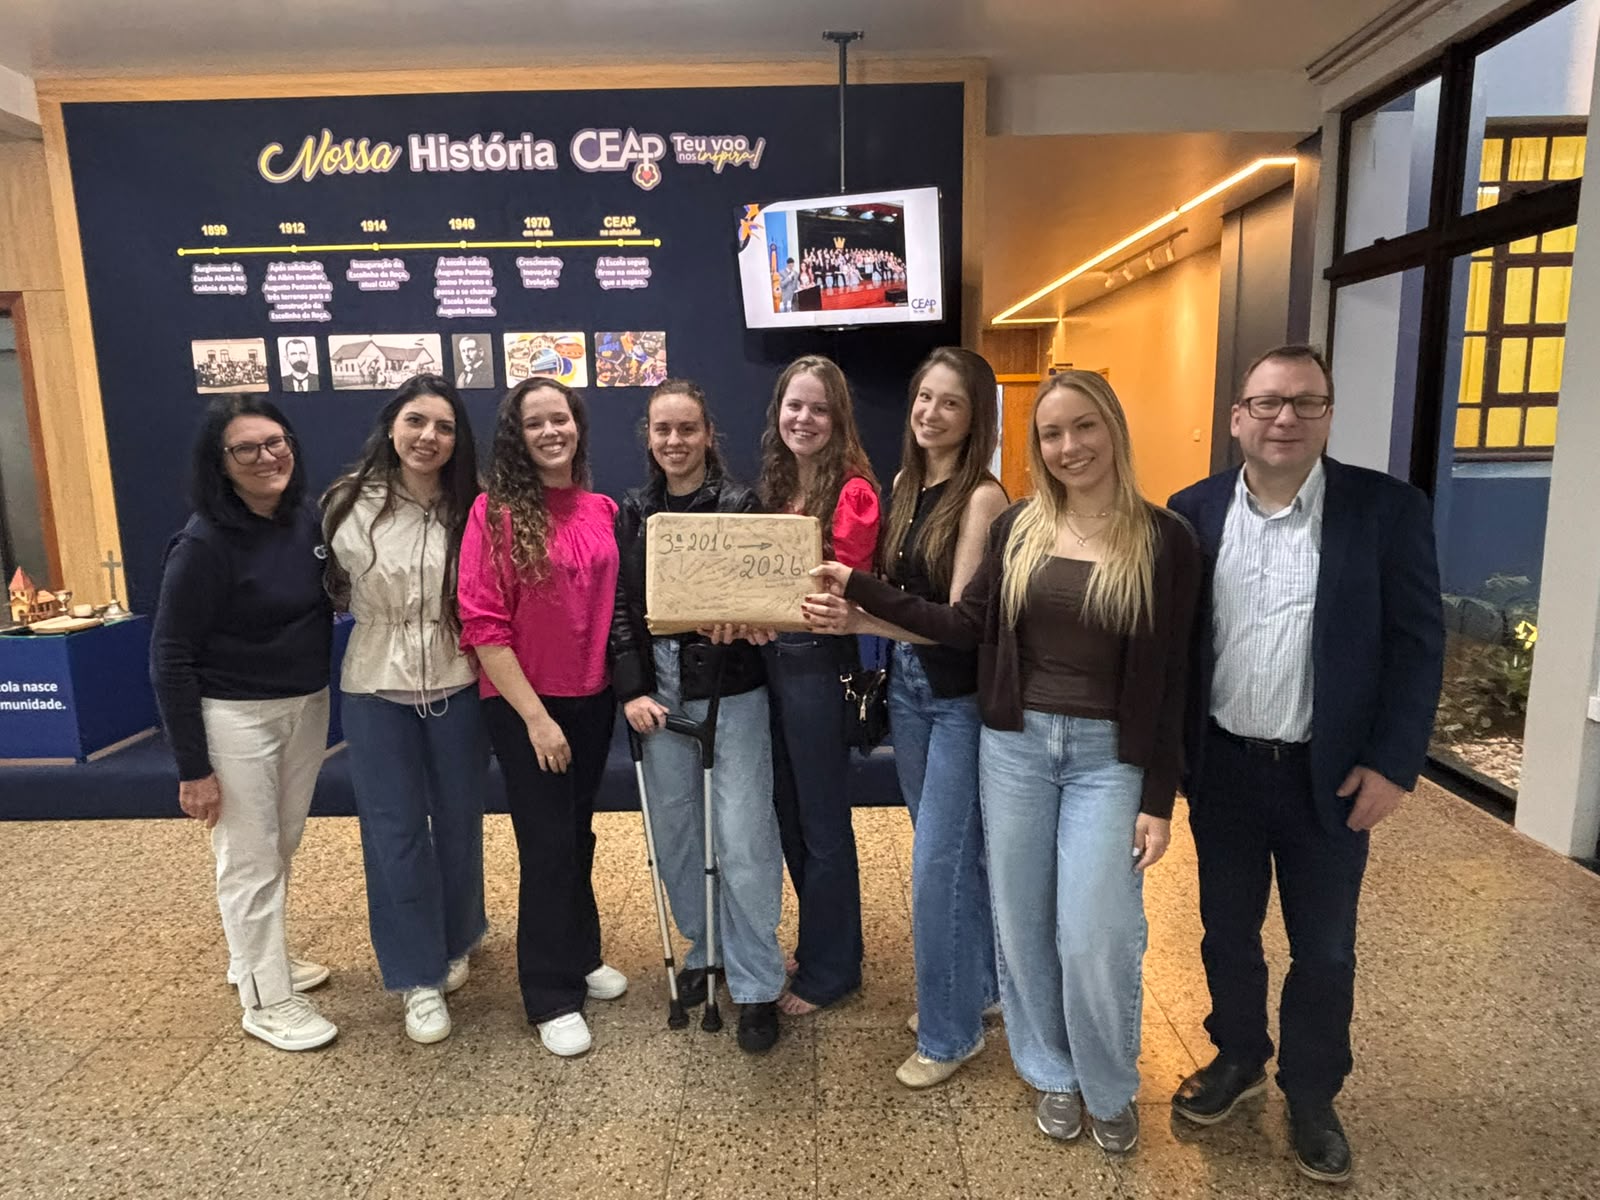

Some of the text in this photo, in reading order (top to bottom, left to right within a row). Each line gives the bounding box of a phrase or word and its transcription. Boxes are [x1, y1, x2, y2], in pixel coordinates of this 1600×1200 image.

[673, 136, 746, 152] Teu voo
[259, 130, 555, 181] Nossa História
[573, 131, 664, 171] CEAP
[680, 152, 696, 161] nos
[279, 222, 305, 234] 1912
[360, 219, 387, 232] 1914
[524, 216, 551, 229] 1970
[604, 216, 636, 228] CEAP
[201, 225, 228, 236] 1899
[912, 298, 936, 310] CEAP
[688, 533, 732, 551] 2016
[22, 683, 58, 692] nasce
